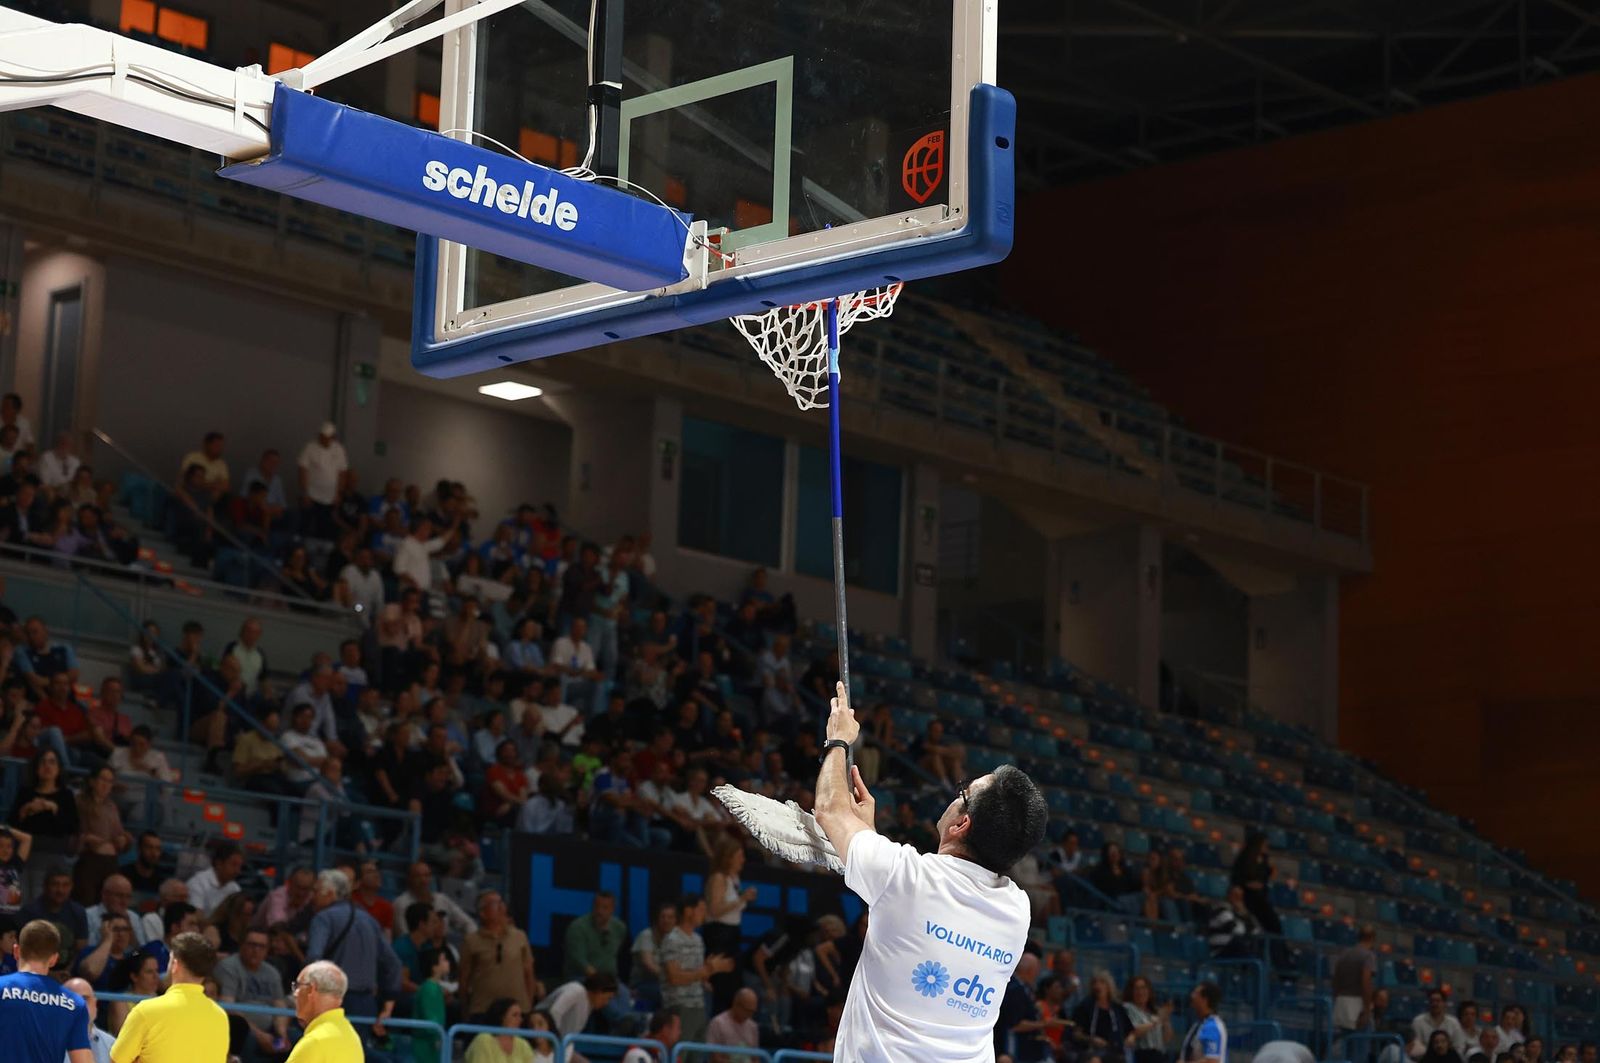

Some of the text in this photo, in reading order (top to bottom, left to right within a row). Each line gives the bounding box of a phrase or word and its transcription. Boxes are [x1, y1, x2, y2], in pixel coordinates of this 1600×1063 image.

[927, 134, 941, 145] FEB
[422, 160, 579, 231] schelde
[925, 920, 1013, 965] VOLUNTARIO
[1, 987, 76, 1011] ARAGONÈS
[953, 974, 995, 1005] chc
